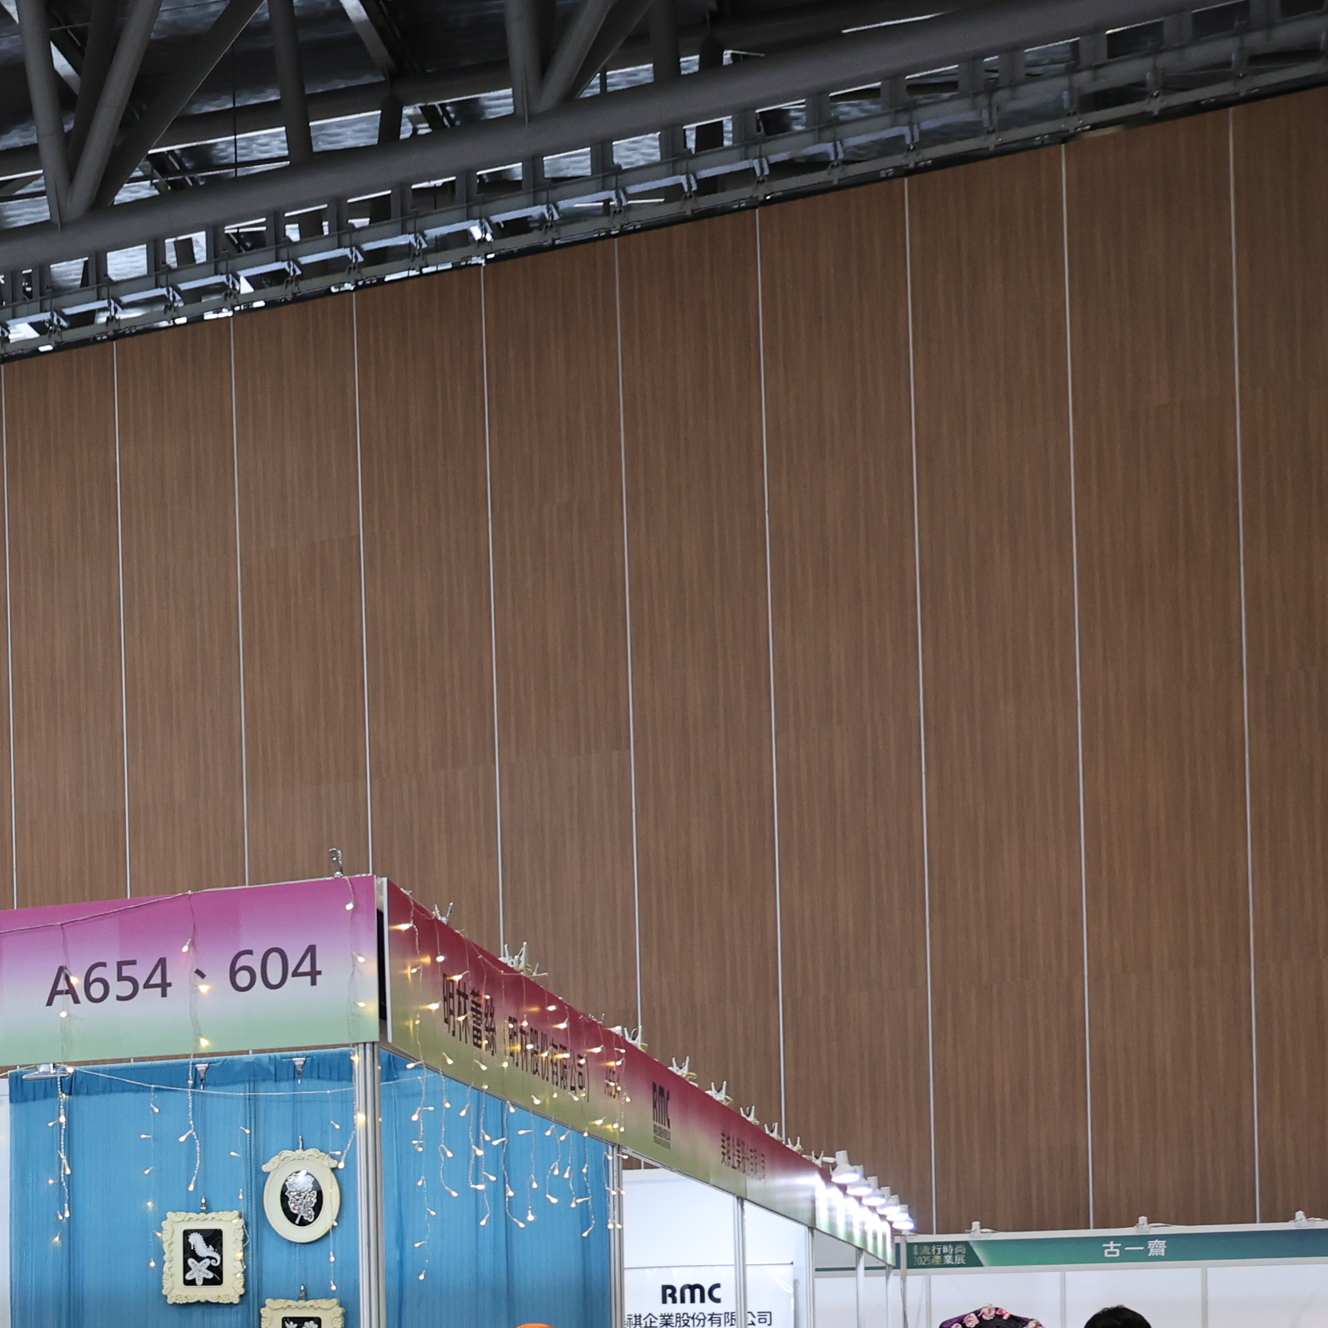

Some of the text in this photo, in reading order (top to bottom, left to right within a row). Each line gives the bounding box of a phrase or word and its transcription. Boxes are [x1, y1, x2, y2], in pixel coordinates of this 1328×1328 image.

[661, 1282, 722, 1304] RMC
[625, 1311, 773, 1328] 祺企業股份有限公司
